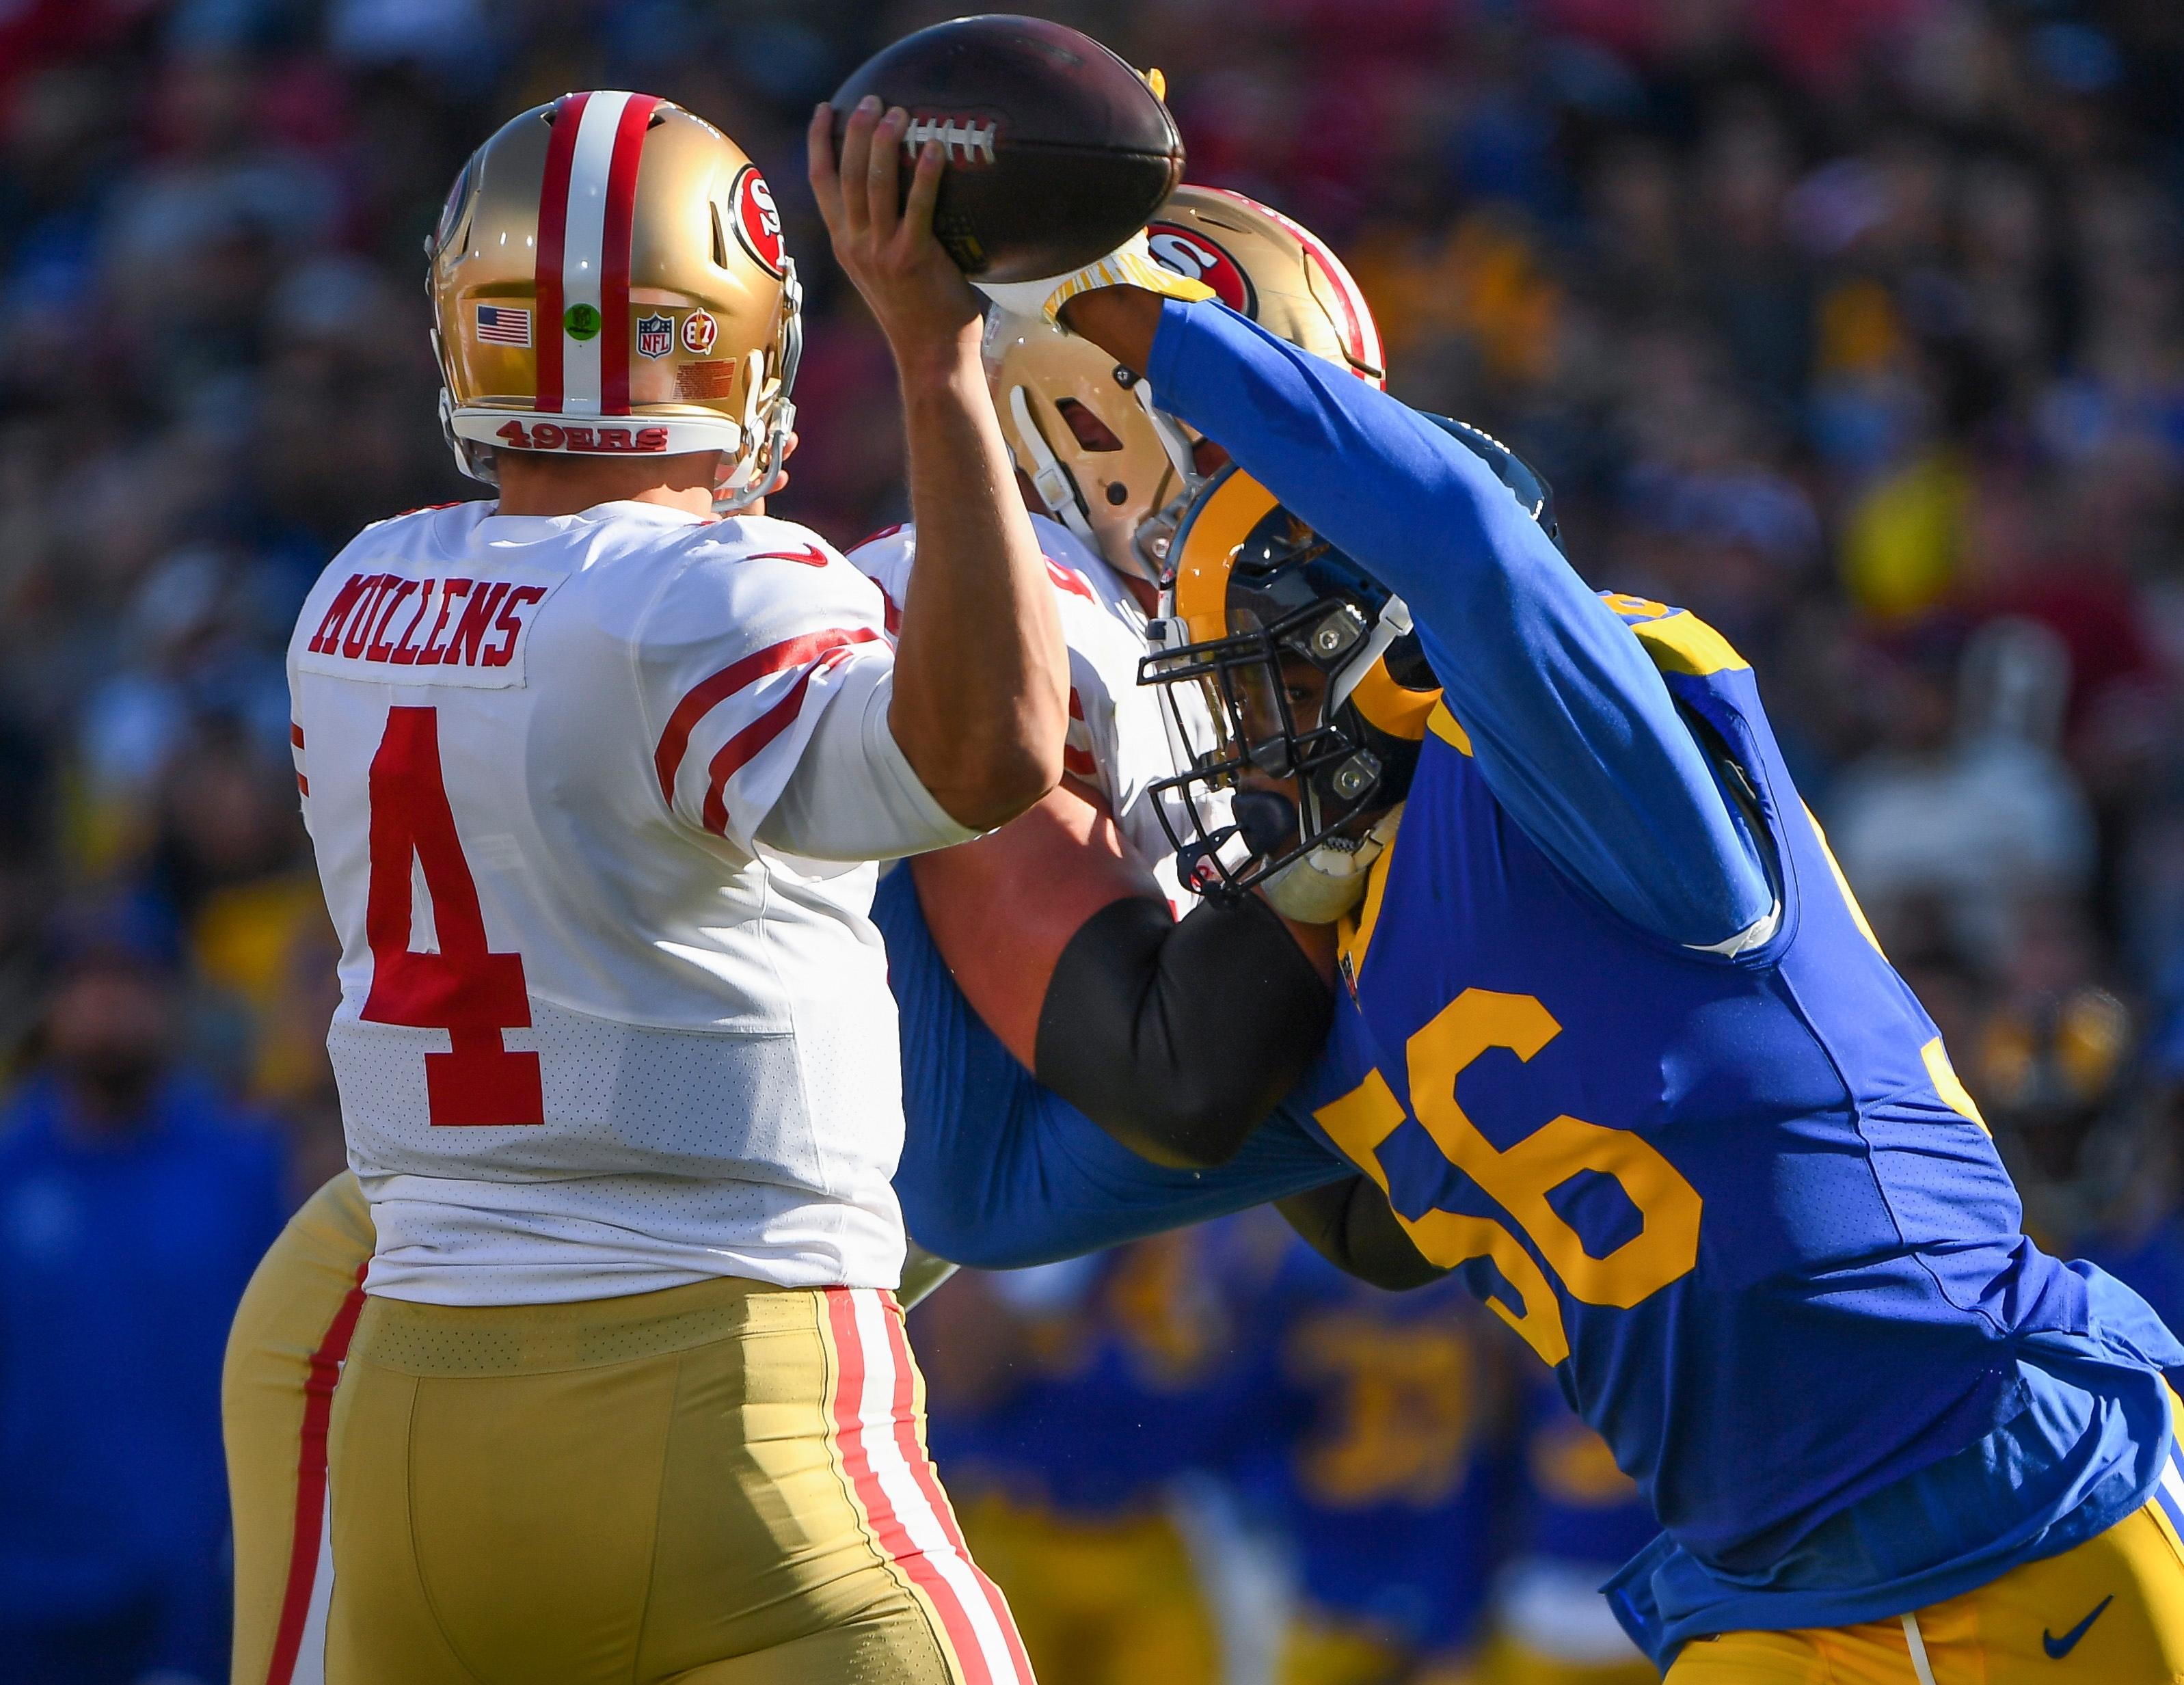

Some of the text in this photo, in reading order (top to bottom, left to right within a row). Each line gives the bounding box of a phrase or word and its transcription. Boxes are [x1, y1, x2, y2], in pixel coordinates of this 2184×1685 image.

[642, 333, 669, 353] NFL
[687, 321, 712, 344] 87
[496, 420, 668, 451] 49ERS
[308, 574, 548, 666] MULLENS
[360, 705, 545, 1126] 4
[1312, 987, 1703, 1367] 56
